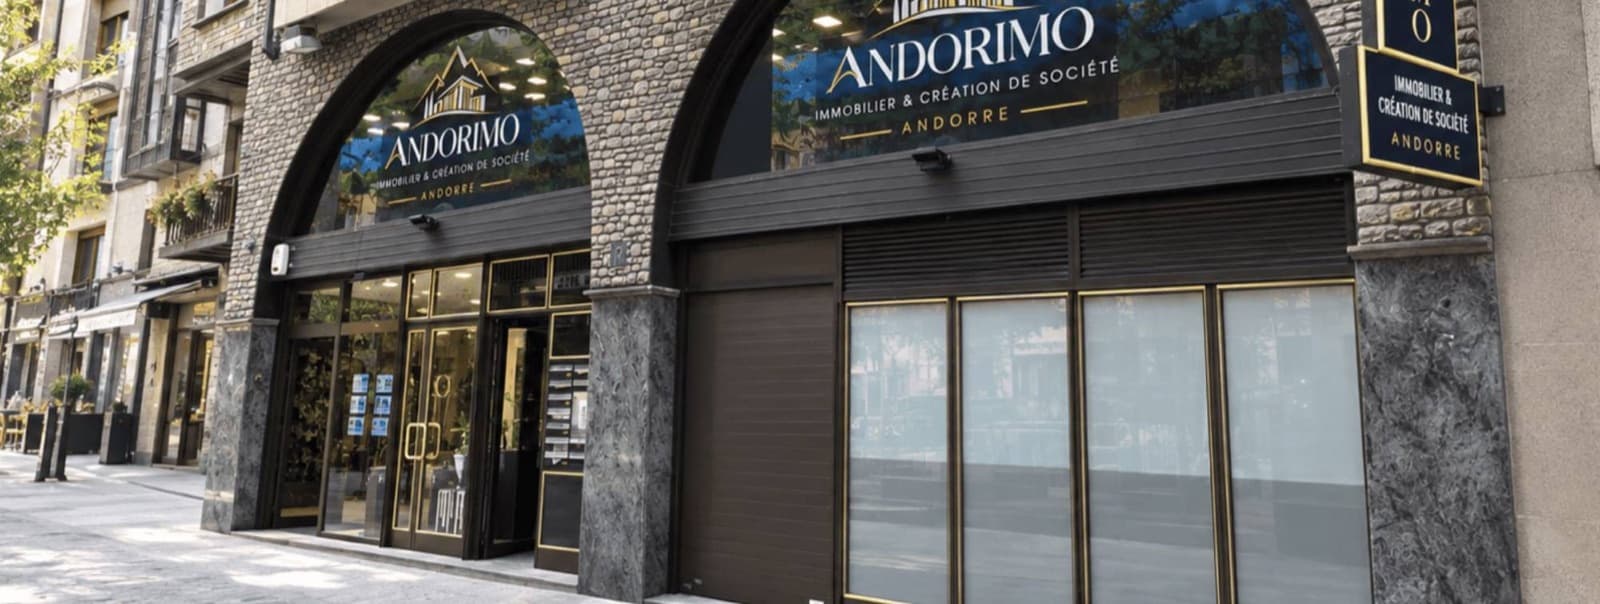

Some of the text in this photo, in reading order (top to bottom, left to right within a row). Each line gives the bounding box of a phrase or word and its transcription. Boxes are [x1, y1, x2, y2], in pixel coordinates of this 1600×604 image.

[1411, 8, 1432, 43] O
[826, 6, 1095, 94] ANDORIMO
[815, 55, 1120, 121] IMMOBILIER & CRÉATION DE SOCIÉTÉ
[1394, 74, 1452, 105] IMMOBILIER &
[902, 106, 1009, 135] ANDORRE
[1378, 95, 1469, 134] CRÉATION DE SOCIÉTÉ
[384, 113, 520, 170] ANDORIMO
[1391, 131, 1461, 161] ANDORRE
[477, 159, 488, 170] DE
[491, 149, 530, 168] SOCIÉTÉ
[420, 182, 475, 201] ANDORRE
